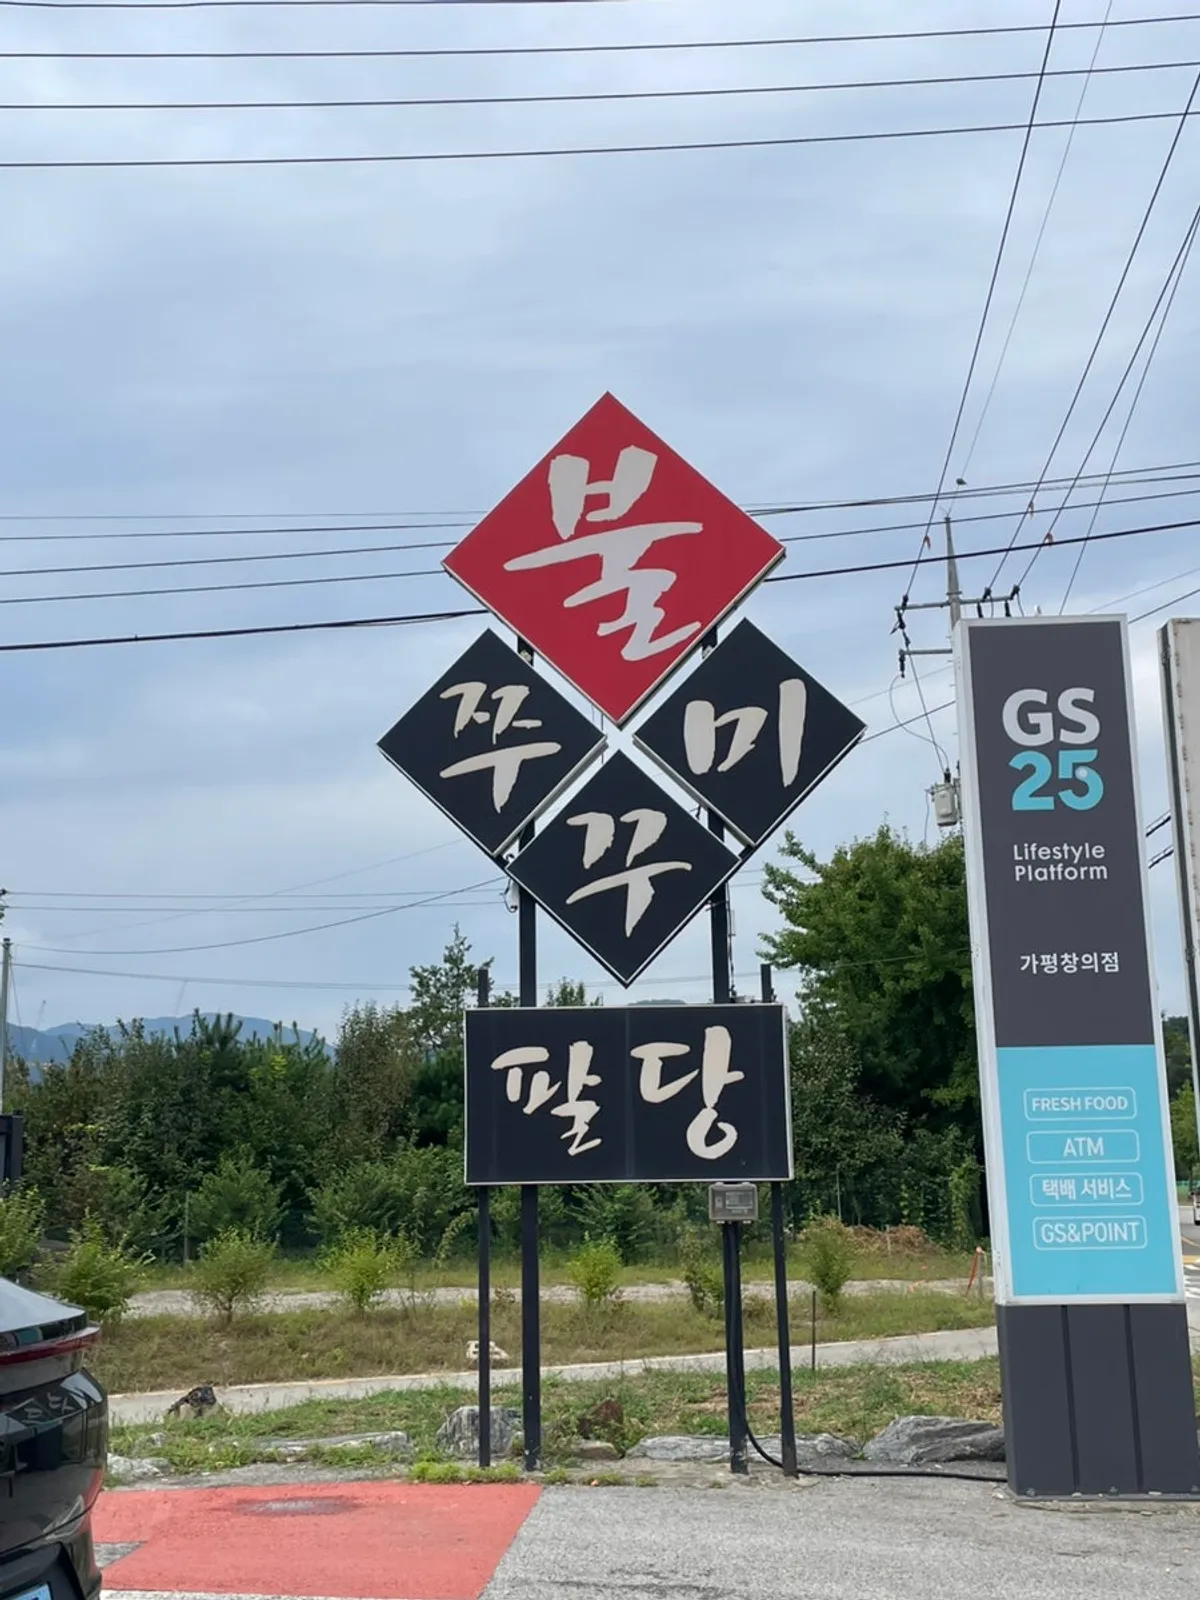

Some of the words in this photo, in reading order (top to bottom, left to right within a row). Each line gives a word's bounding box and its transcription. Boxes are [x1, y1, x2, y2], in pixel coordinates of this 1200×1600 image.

[504, 446, 703, 661] 불
[684, 678, 807, 788] 미
[1002, 687, 1100, 747] GS
[439, 682, 562, 813] 쭈
[1008, 749, 1104, 811] 25
[566, 809, 692, 937] 꾸
[1013, 842, 1105, 863] Lifestyle
[1015, 862, 1108, 882] Platform
[1020, 952, 1119, 974] 가평창의점
[491, 1025, 744, 1159] 팔당
[1032, 1097, 1081, 1112] FRESH
[1085, 1096, 1128, 1110] FOOD
[1063, 1137, 1104, 1157] ATM
[1042, 1179, 1076, 1200] 택배
[1081, 1178, 1132, 1200] 서비스
[1041, 1222, 1140, 1244] GS&POINT
